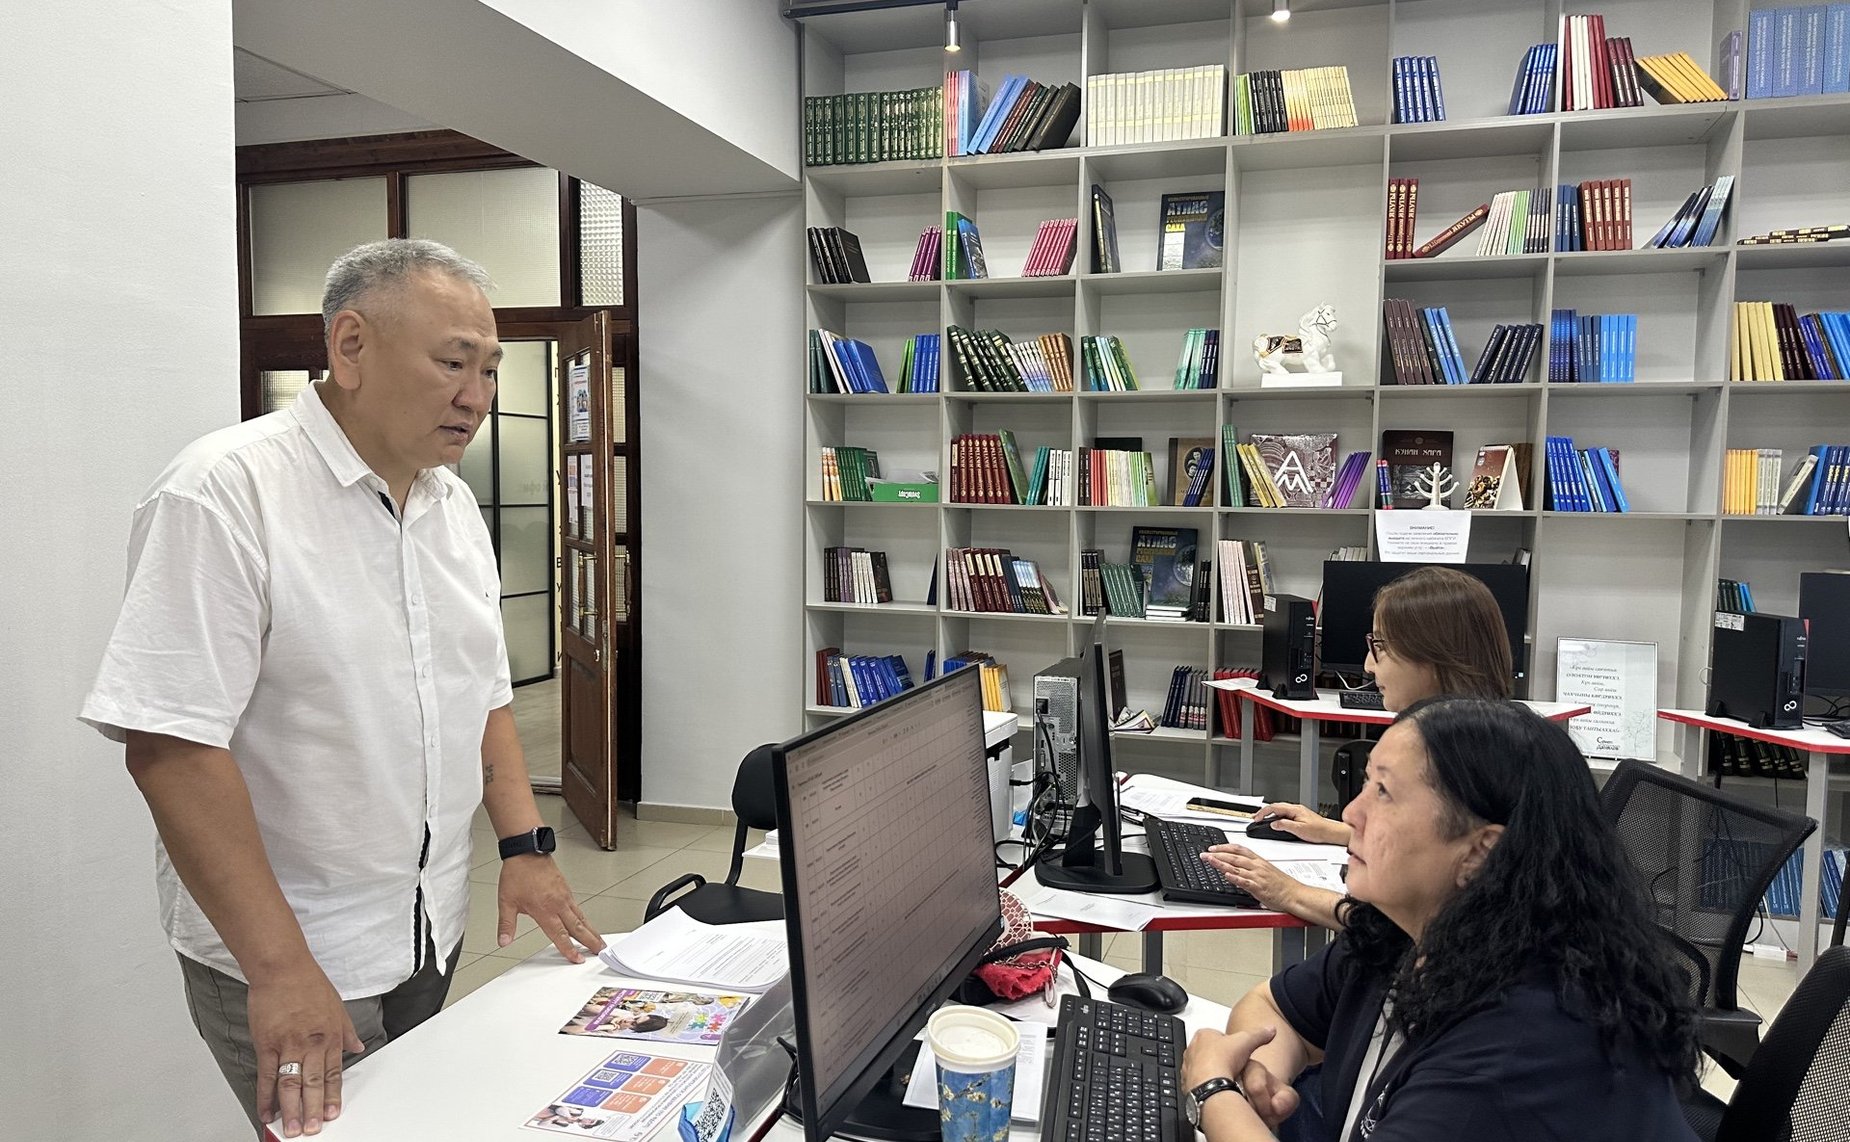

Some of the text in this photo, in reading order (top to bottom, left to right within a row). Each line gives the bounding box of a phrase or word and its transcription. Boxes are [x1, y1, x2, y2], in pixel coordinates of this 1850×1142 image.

[1167, 200, 1208, 216] АТЛАС
[1388, 193, 1397, 218] ЯКУТЫ
[1398, 193, 1406, 218] ЯКУТЫ
[1408, 193, 1416, 218] ЯКУТЫ
[1451, 213, 1476, 234] ЯКУТЫ
[1137, 535, 1177, 549] АТЛАС
